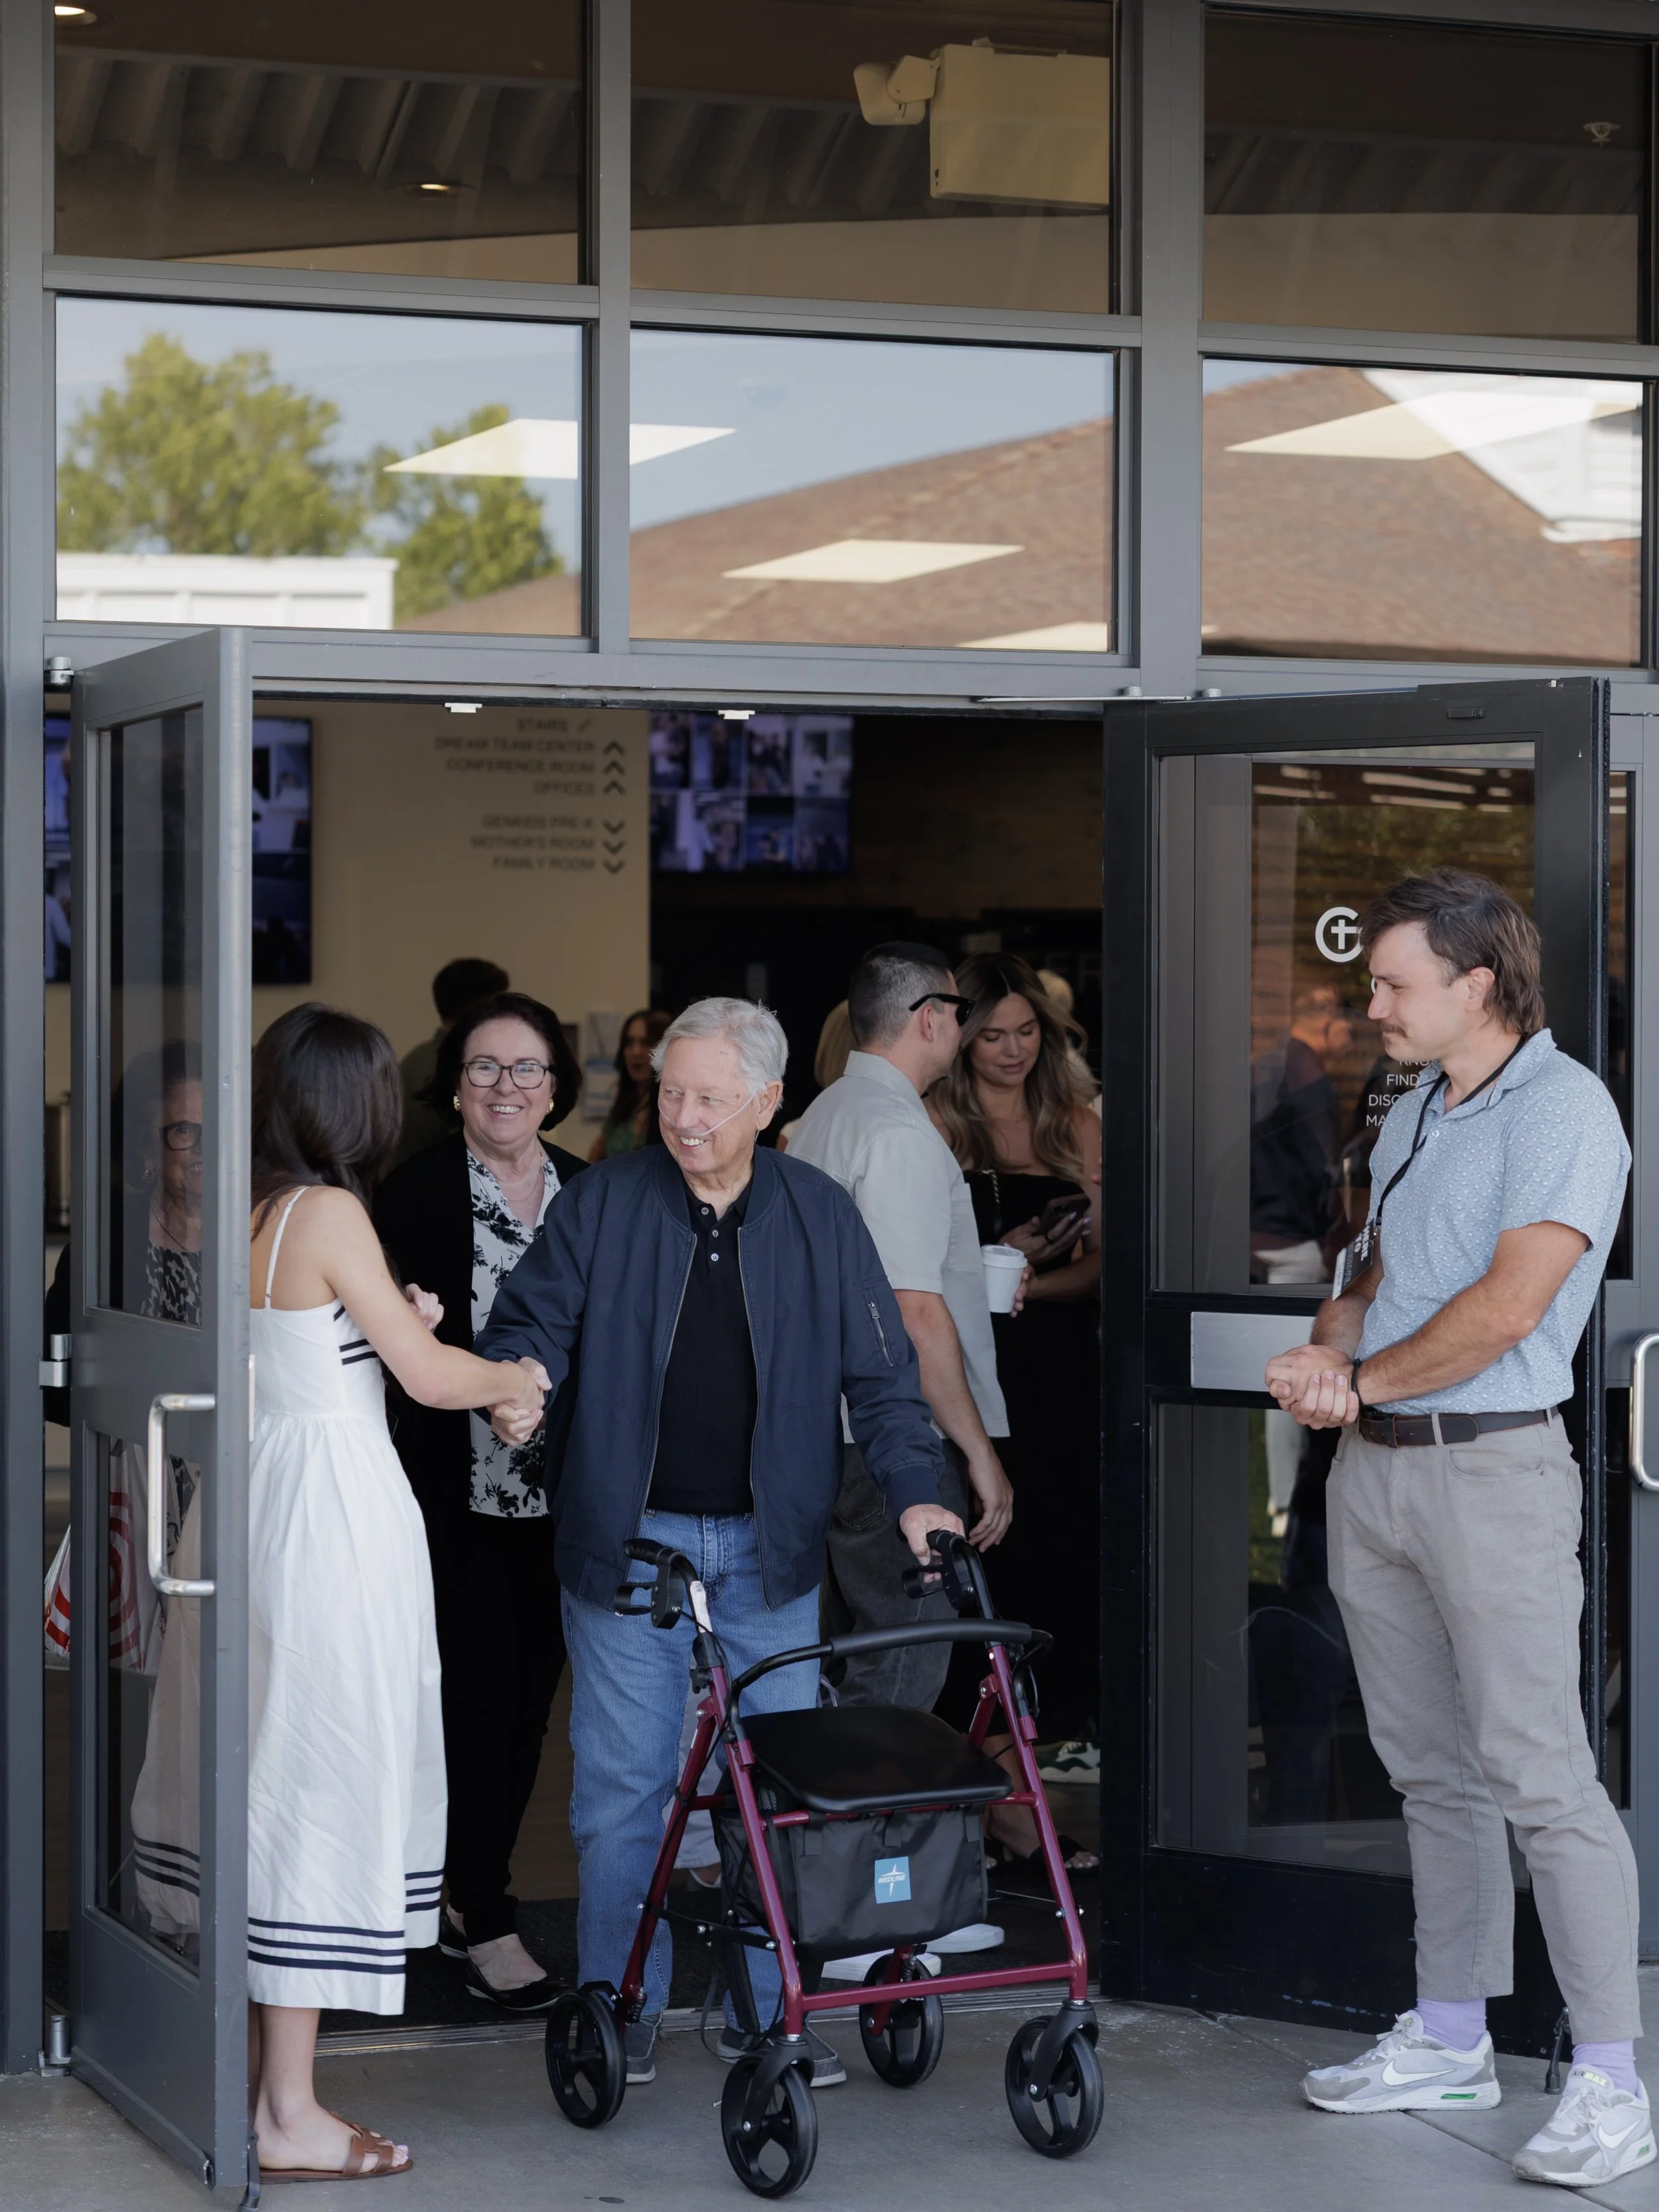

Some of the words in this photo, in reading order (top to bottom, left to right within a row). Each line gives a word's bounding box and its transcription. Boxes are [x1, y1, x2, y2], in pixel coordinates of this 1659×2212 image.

[516, 717, 568, 733] STAIRS
[434, 736, 488, 750] DREAM
[492, 737, 533, 752] TEAM
[536, 739, 596, 753] CENTER
[445, 757, 545, 773] CONFERENCE
[549, 759, 596, 774] ROOM
[533, 780, 596, 795] OFFICES
[549, 836, 596, 851] ROOM
[492, 855, 544, 870] FAMILY
[549, 856, 596, 870] ROOM
[1386, 1074, 1419, 1086] FIND
[1354, 1232, 1363, 1252] TO
[878, 1874, 906, 1883] MEDLINE
